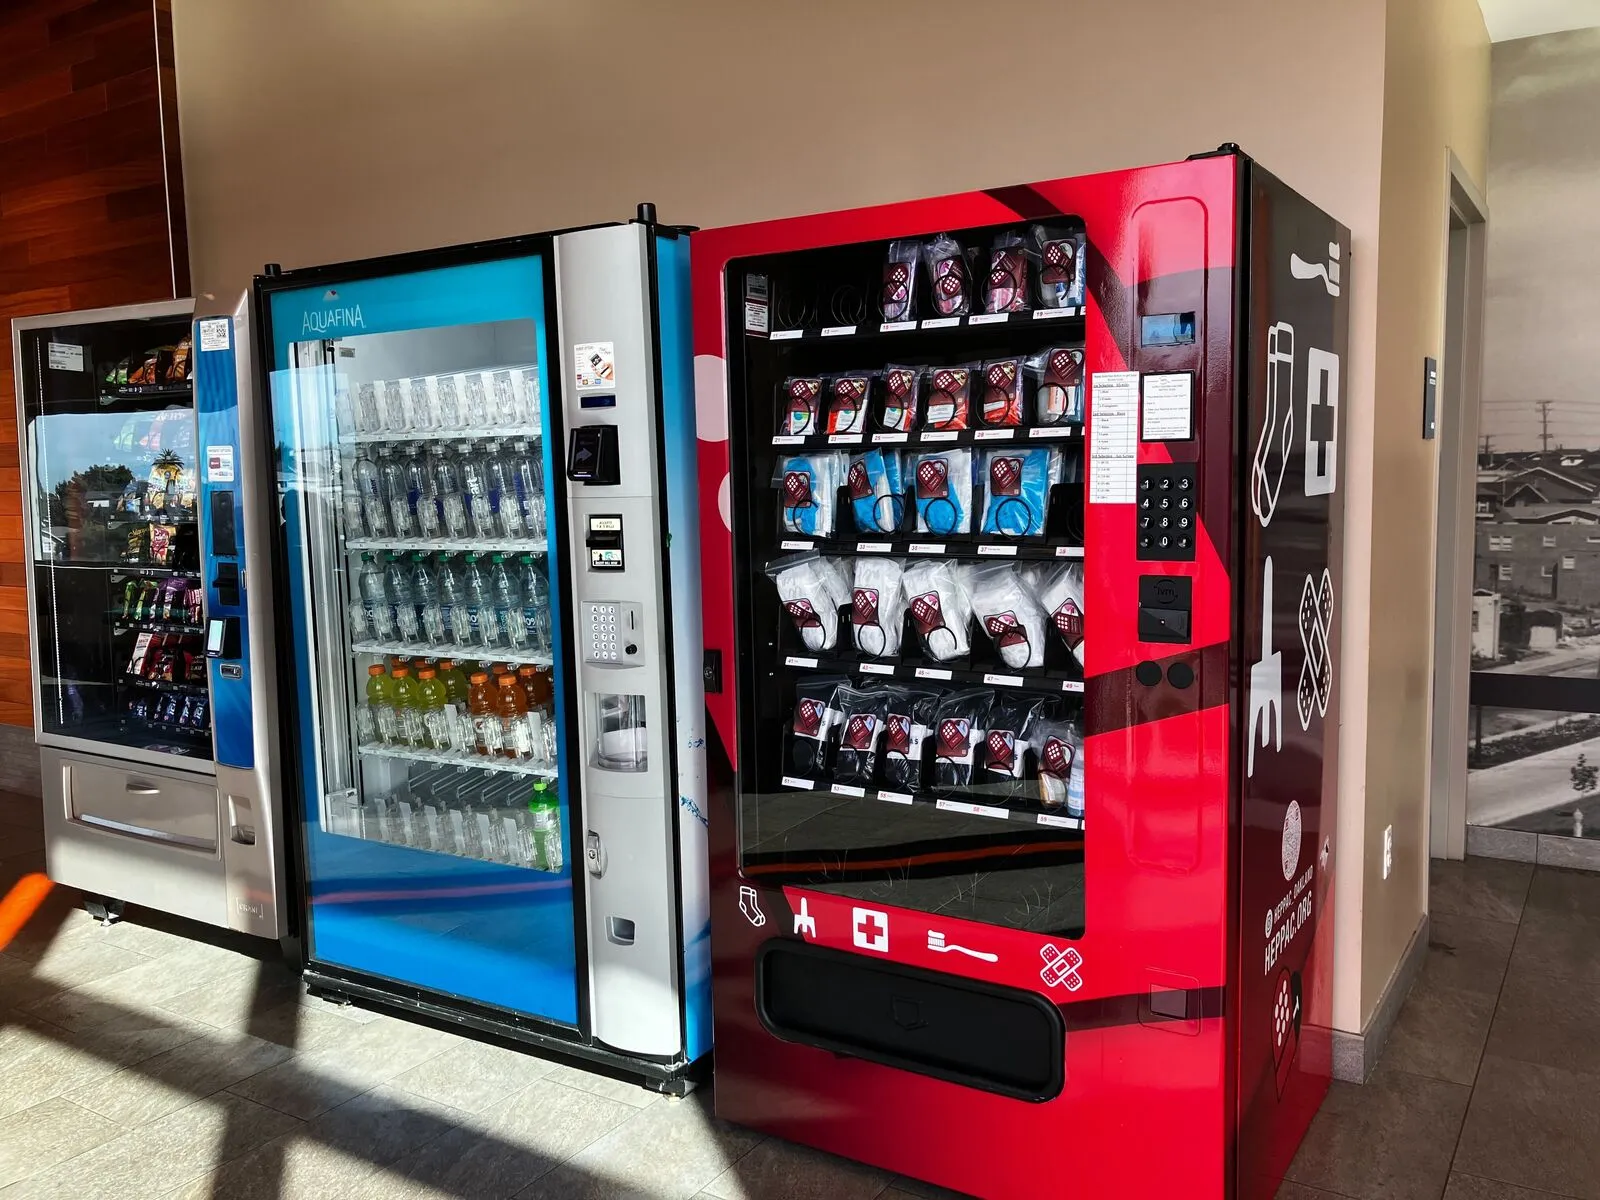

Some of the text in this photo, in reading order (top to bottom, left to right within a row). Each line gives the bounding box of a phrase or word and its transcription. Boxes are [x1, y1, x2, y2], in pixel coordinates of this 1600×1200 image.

[302, 304, 366, 336] AQUAFINA
[1144, 479, 1188, 489] 1 2 3
[1143, 498, 1188, 508] 4 5 6
[1144, 518, 1188, 527] 7 8 9
[1162, 536, 1168, 546] 0
[1274, 864, 1313, 924] HEPPAC_OAKLAND
[1264, 890, 1312, 976] HEPPAC.ORG
